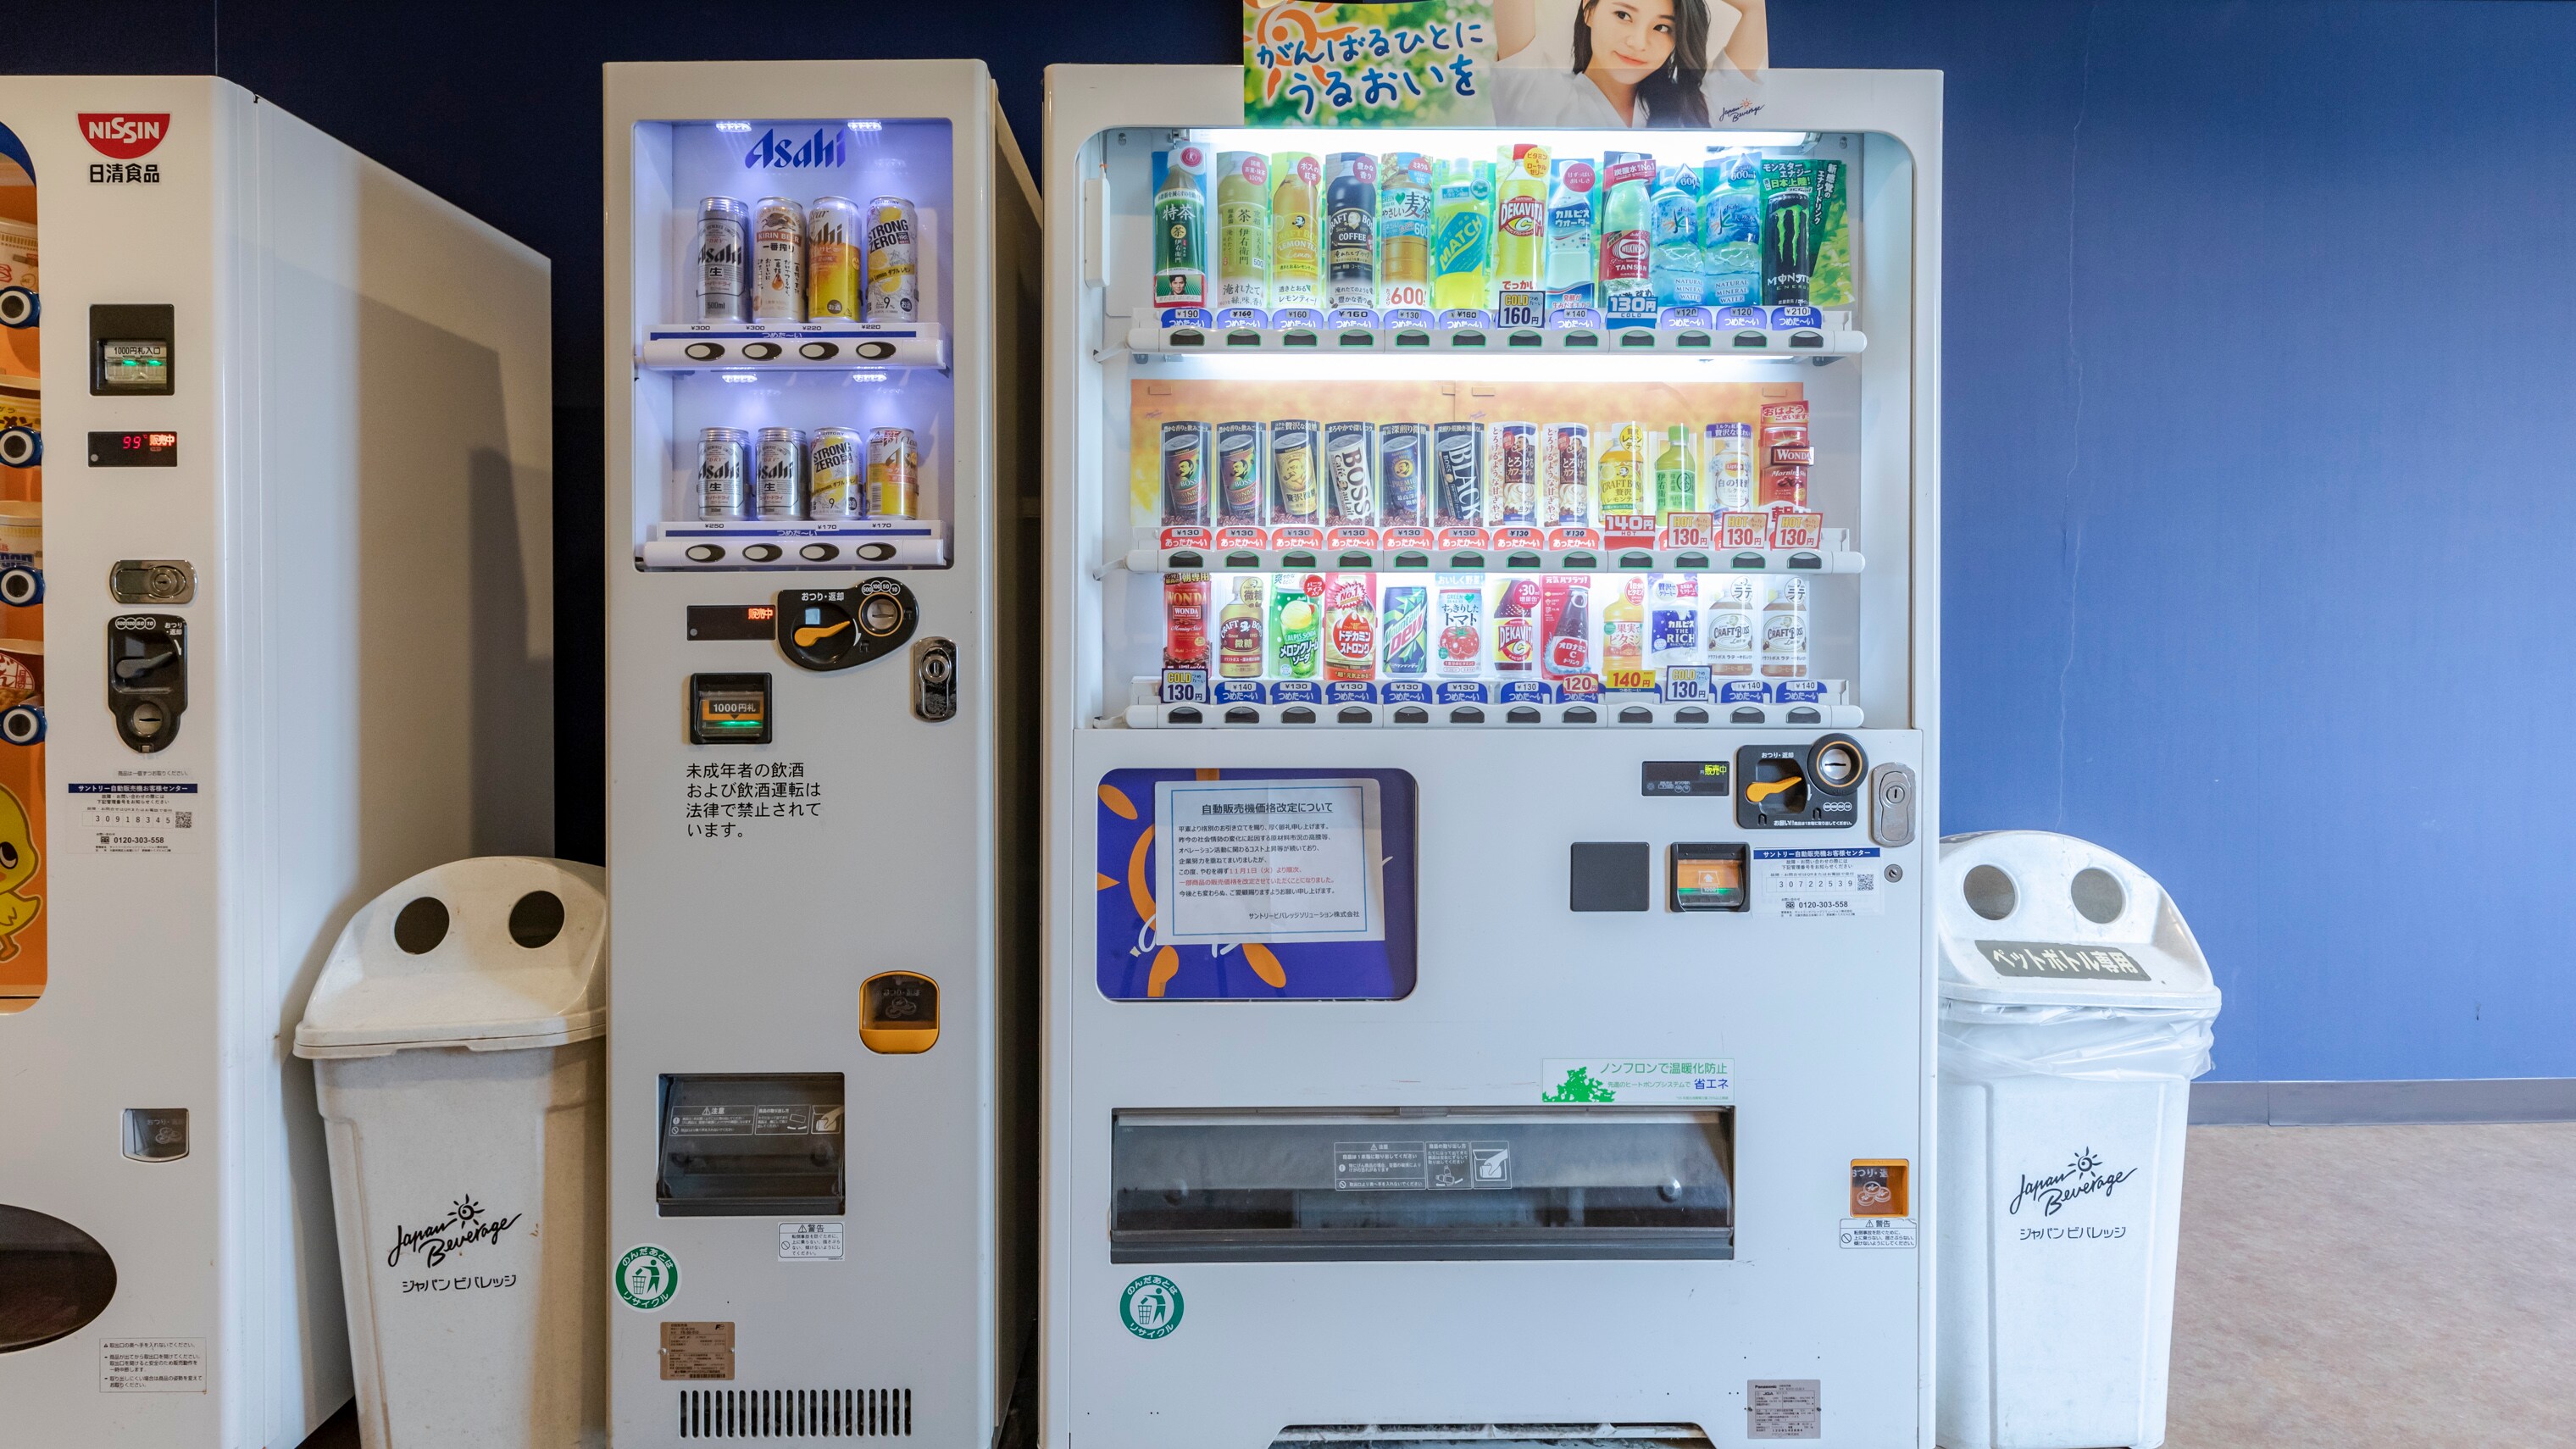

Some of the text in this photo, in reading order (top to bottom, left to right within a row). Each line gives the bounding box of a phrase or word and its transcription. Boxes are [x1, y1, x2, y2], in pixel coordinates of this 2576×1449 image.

[1257, 22, 1485, 69] がんばるひとに
[1288, 53, 1476, 115] うるおいを
[89, 117, 159, 144] NISSIN
[745, 128, 847, 169] Asahi
[1301, 162, 1319, 174] ボスの
[1357, 163, 1374, 171] 豊かな
[1763, 162, 1803, 172] モンスター
[89, 164, 160, 183] 日清食品
[1304, 173, 1317, 181] 紅茶
[1360, 172, 1372, 180] 香り
[1779, 169, 1812, 178] エナジー
[1824, 163, 1838, 199] 新感覚の
[1162, 203, 1196, 223] 特茶
[1238, 208, 1251, 223] 茶
[1556, 209, 1590, 219] カルピス
[868, 219, 909, 242] STRONG
[1338, 231, 1368, 242] COFFEE
[781, 233, 800, 243] BEER
[870, 233, 897, 254] ZERO
[1440, 215, 1482, 265] MATCH
[763, 242, 795, 253] 一番搾り
[1239, 227, 1249, 265] 伊右衛門
[698, 243, 742, 265] Asahi
[710, 267, 723, 277] 生
[1223, 283, 1261, 296] 淹れたて
[1505, 294, 1529, 305] COLD
[1610, 297, 1657, 312] 130円
[1177, 310, 1199, 319] ¥190
[1288, 310, 1307, 319] ¥160
[1400, 311, 1419, 319] ¥130
[1504, 308, 1539, 325] 160円
[1566, 310, 1585, 319] ¥140
[1732, 308, 1752, 316] ¥120
[1763, 406, 1804, 417] おはよう
[149, 435, 175, 447] 販売中
[813, 441, 852, 464] STRONG
[815, 456, 841, 473] ZERO
[709, 482, 722, 491] 生
[764, 482, 775, 491] 生
[1180, 479, 1198, 487] BOSS
[1235, 479, 1252, 487] BOSS
[1343, 447, 1371, 516] BOSS
[1449, 445, 1481, 519] BLACK
[1606, 517, 1654, 530] 140円
[1673, 516, 1693, 527] HOT
[1728, 516, 1748, 527] HOT
[1781, 516, 1802, 527] HOT
[1673, 528, 1707, 546] 130円
[1727, 528, 1762, 546] 130円
[1780, 528, 1815, 546] 130円
[801, 591, 845, 602] おつり・返却
[1166, 591, 1208, 606] WONDA
[1244, 590, 1263, 601] 微糖
[747, 608, 773, 619] 販売中
[1441, 603, 1479, 613] すっきりした
[1445, 613, 1477, 626] トマト
[1339, 630, 1371, 641] ドデカミン
[1667, 633, 1695, 644] RICH
[1768, 628, 1789, 640] CRAFT
[1235, 639, 1252, 648] 微糖
[1280, 640, 1319, 657] メロンクリーム
[1340, 642, 1369, 654] ストロング
[1558, 641, 1586, 653] オロナミン
[1293, 653, 1311, 664] ソーダ
[1168, 673, 1191, 683] COLD
[1613, 672, 1651, 688] 140円
[1672, 669, 1696, 680] COLD
[1565, 677, 1598, 691] 120円
[1671, 681, 1706, 698] 130円
[1168, 685, 1202, 701] 130円
[713, 702, 756, 713] 1000円札
[686, 762, 805, 780] 未成年者の飲酒
[1704, 764, 1727, 775] 販売中
[686, 782, 821, 799] および飲酒運転は
[686, 802, 821, 819] 法律で禁止されて
[1202, 802, 1333, 814] 自動販売機価格改定について
[686, 822, 744, 838] います。
[1763, 849, 1871, 858] サントリー自動販売機お客様センター
[1992, 948, 2139, 974] ペットボトル専用
[1600, 1063, 1728, 1074] ノンフロンで温暖化防止
[1694, 1078, 1729, 1090] 省エネ
[2009, 1169, 2076, 1215] Japan
[2037, 1167, 2139, 1218] Beverage
[808, 1224, 824, 1233] 警告
[2019, 1226, 2126, 1241] ジャパン ビバレッジ
[387, 1218, 458, 1268] Japan
[418, 1213, 523, 1269] Beverage
[622, 1247, 674, 1269] のんだあとは
[402, 1274, 517, 1293] ジャパン ビバレッジ
[1127, 1276, 1178, 1296] のんだあとは
[623, 1291, 669, 1308] リサイクル
[1130, 1322, 1174, 1339] リサイクル
